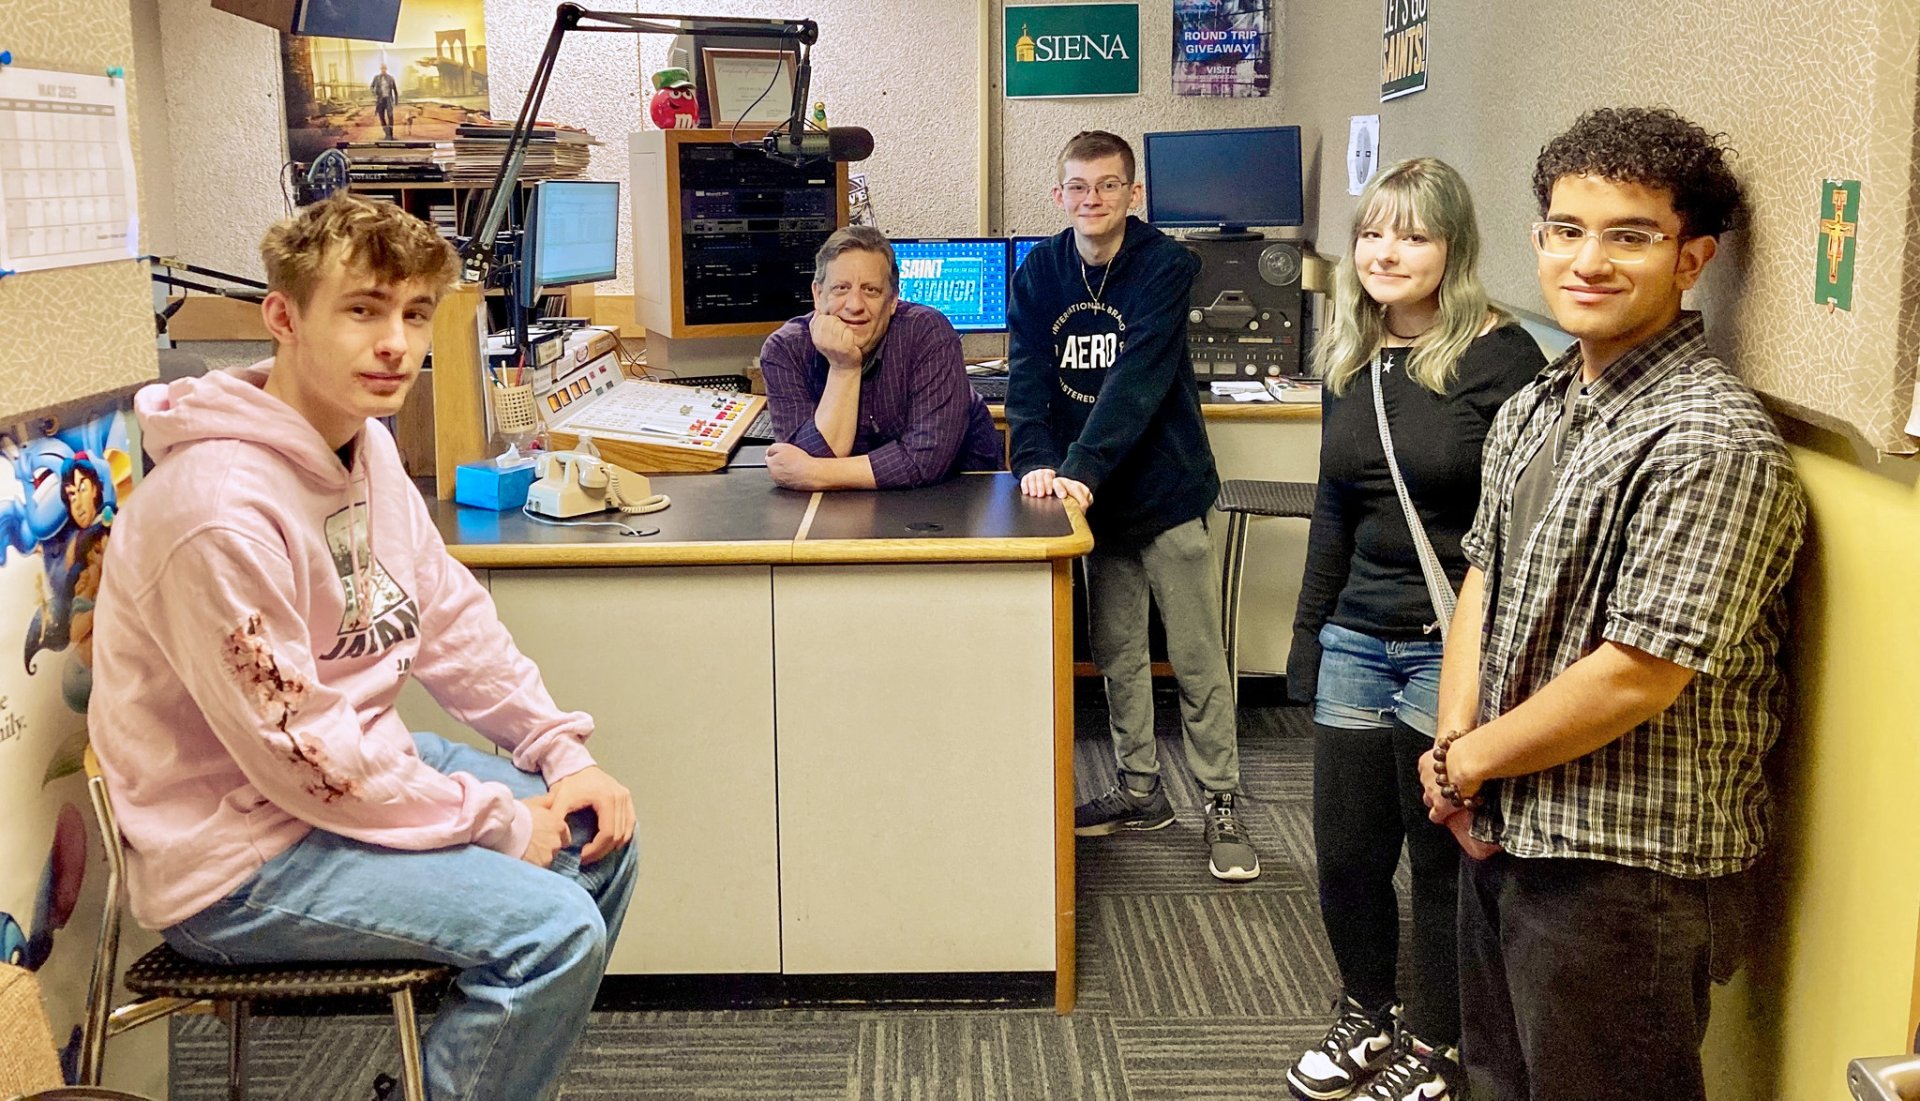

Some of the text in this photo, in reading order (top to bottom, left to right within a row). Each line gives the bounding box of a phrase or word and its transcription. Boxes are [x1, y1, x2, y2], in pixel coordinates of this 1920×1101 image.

[1184, 30, 1257, 40] ROUND TRIP
[1035, 34, 1130, 62] SIENA
[1186, 43, 1255, 53] GIVEAWAY!
[1382, 21, 1427, 85] SAINTS!
[900, 258, 945, 280] SAINT
[1060, 332, 1117, 369] AERO
